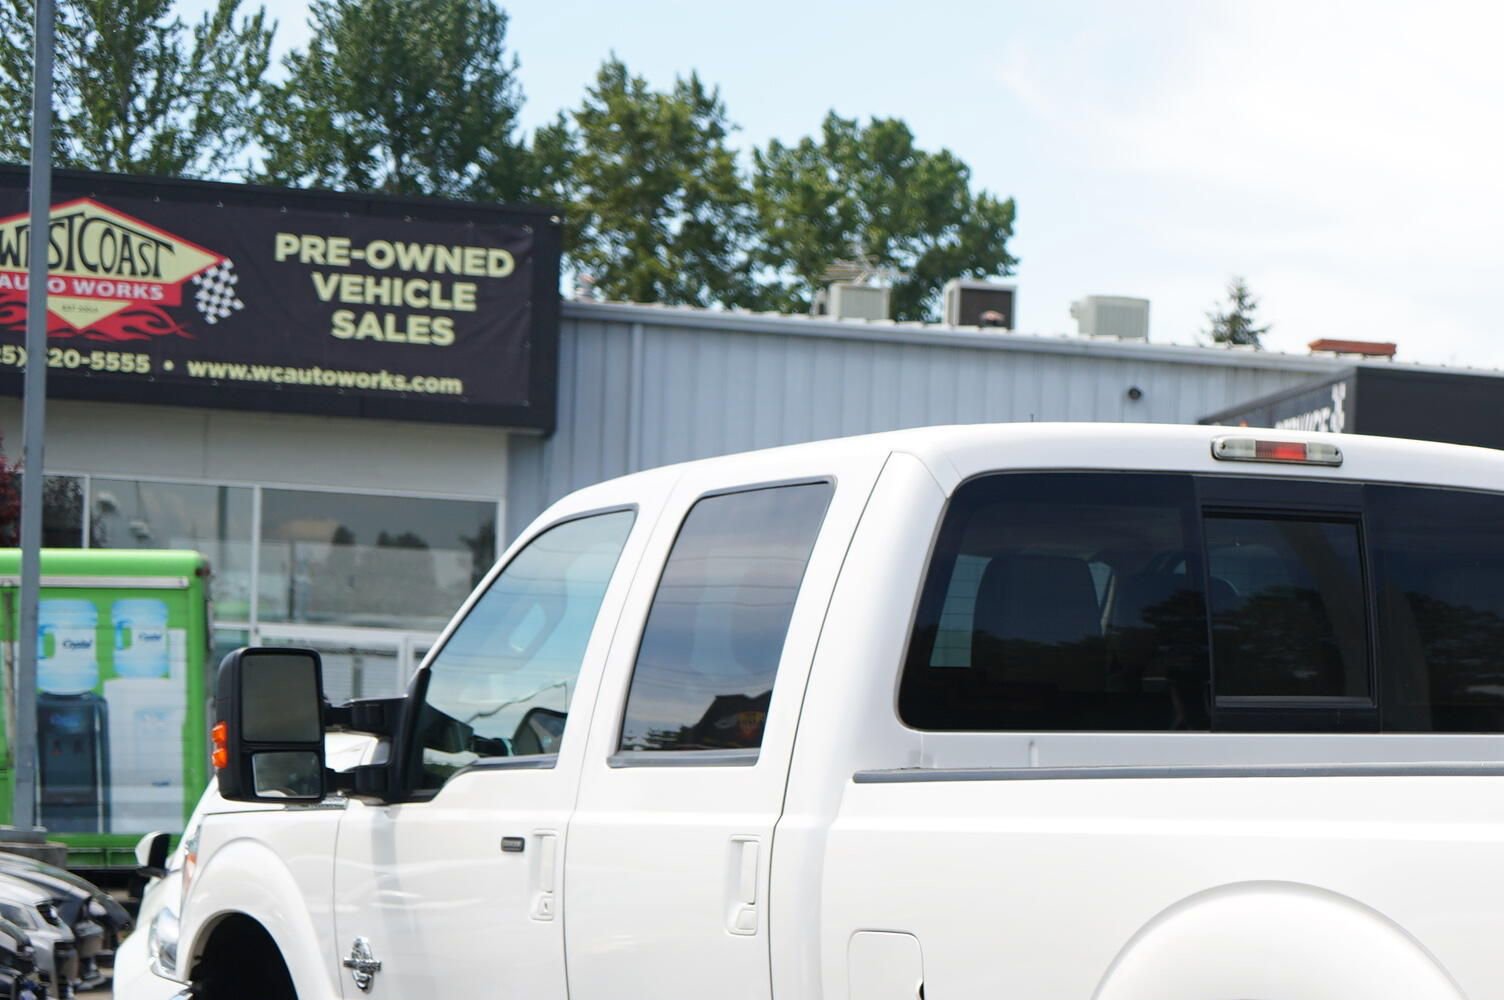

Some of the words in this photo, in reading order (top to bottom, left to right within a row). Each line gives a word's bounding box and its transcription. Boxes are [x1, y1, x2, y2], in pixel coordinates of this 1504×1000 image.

[275, 232, 515, 278] PRE-OWNED
[0, 277, 66, 293] AUO
[72, 279, 164, 301] WORKS
[312, 271, 477, 312] VEHICLE
[331, 309, 455, 346] SALES
[46, 347, 151, 374] 20-5555
[187, 360, 463, 395] www.wcautoworks.com
